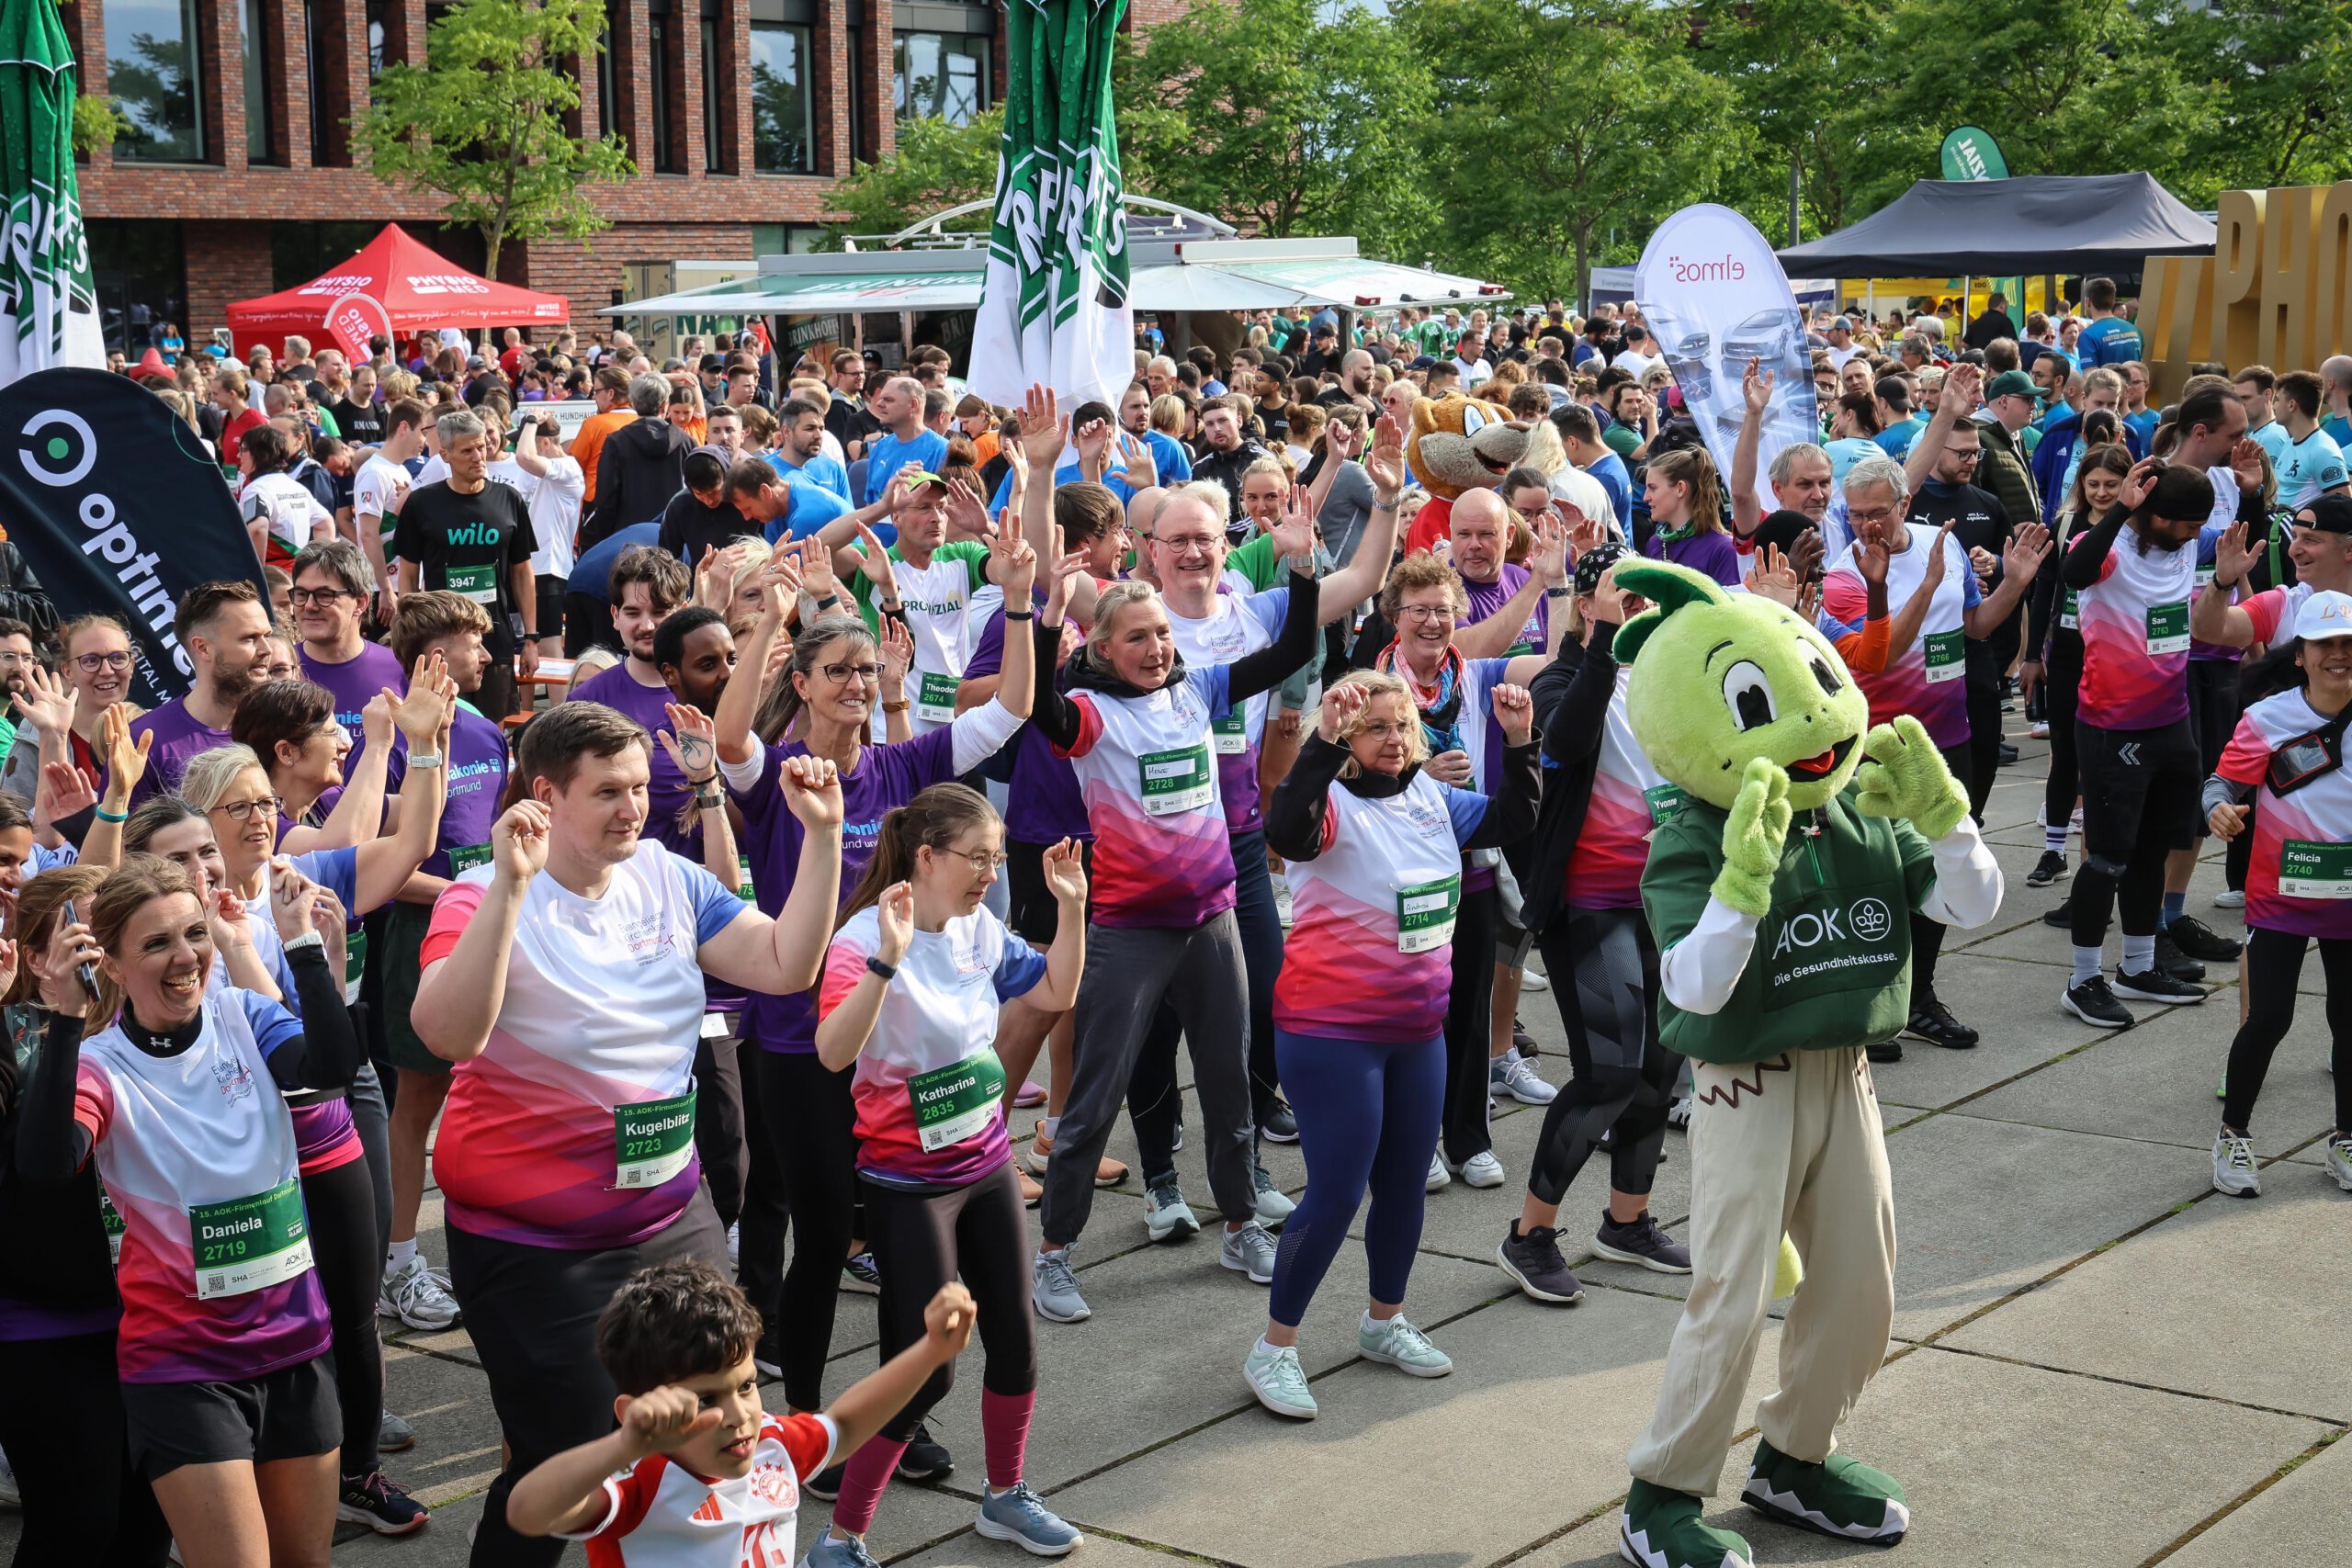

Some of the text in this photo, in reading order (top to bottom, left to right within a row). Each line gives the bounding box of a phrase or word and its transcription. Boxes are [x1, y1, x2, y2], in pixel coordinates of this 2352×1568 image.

[313, 275, 372, 288] PHYSIO
[406, 275, 479, 287] PHYSIO
[805, 276, 985, 295] BRINKHO
[322, 287, 361, 297] MED
[448, 285, 490, 295] MED
[941, 313, 974, 344] BRI
[447, 521, 500, 546] wilo
[449, 576, 475, 589] 3947
[2152, 616, 2166, 626] Sam
[1930, 644, 1946, 653] Dirk
[1930, 653, 1950, 664] 2766
[926, 682, 956, 694] Theodor
[924, 694, 944, 703] 2674
[447, 780, 481, 800] ortmund
[1148, 778, 1174, 790] 2728
[1654, 797, 1677, 809] Yvonne
[2288, 852, 2321, 863] Felicia
[458, 859, 482, 871] Felix
[2287, 864, 2312, 875] 2740
[1405, 914, 1430, 927] 2714
[1772, 907, 1847, 960] AOK
[1774, 952, 1898, 987] Die Gesundheitskasse.
[919, 1076, 976, 1103] Katharina
[637, 1100, 689, 1113] AOK-Firmenlauf
[922, 1100, 956, 1121] 2835
[625, 1111, 690, 1138] Kugelblitz
[945, 1127, 958, 1136] SHA
[626, 1139, 662, 1156] 2723
[646, 1168, 660, 1177] SHA
[199, 1210, 212, 1219] 15.
[213, 1194, 273, 1216] AOK-Firmenlauf
[201, 1215, 263, 1240] Daniela
[204, 1240, 246, 1262] 2719
[232, 1274, 249, 1283] SHA
[285, 1251, 301, 1267] AOK
